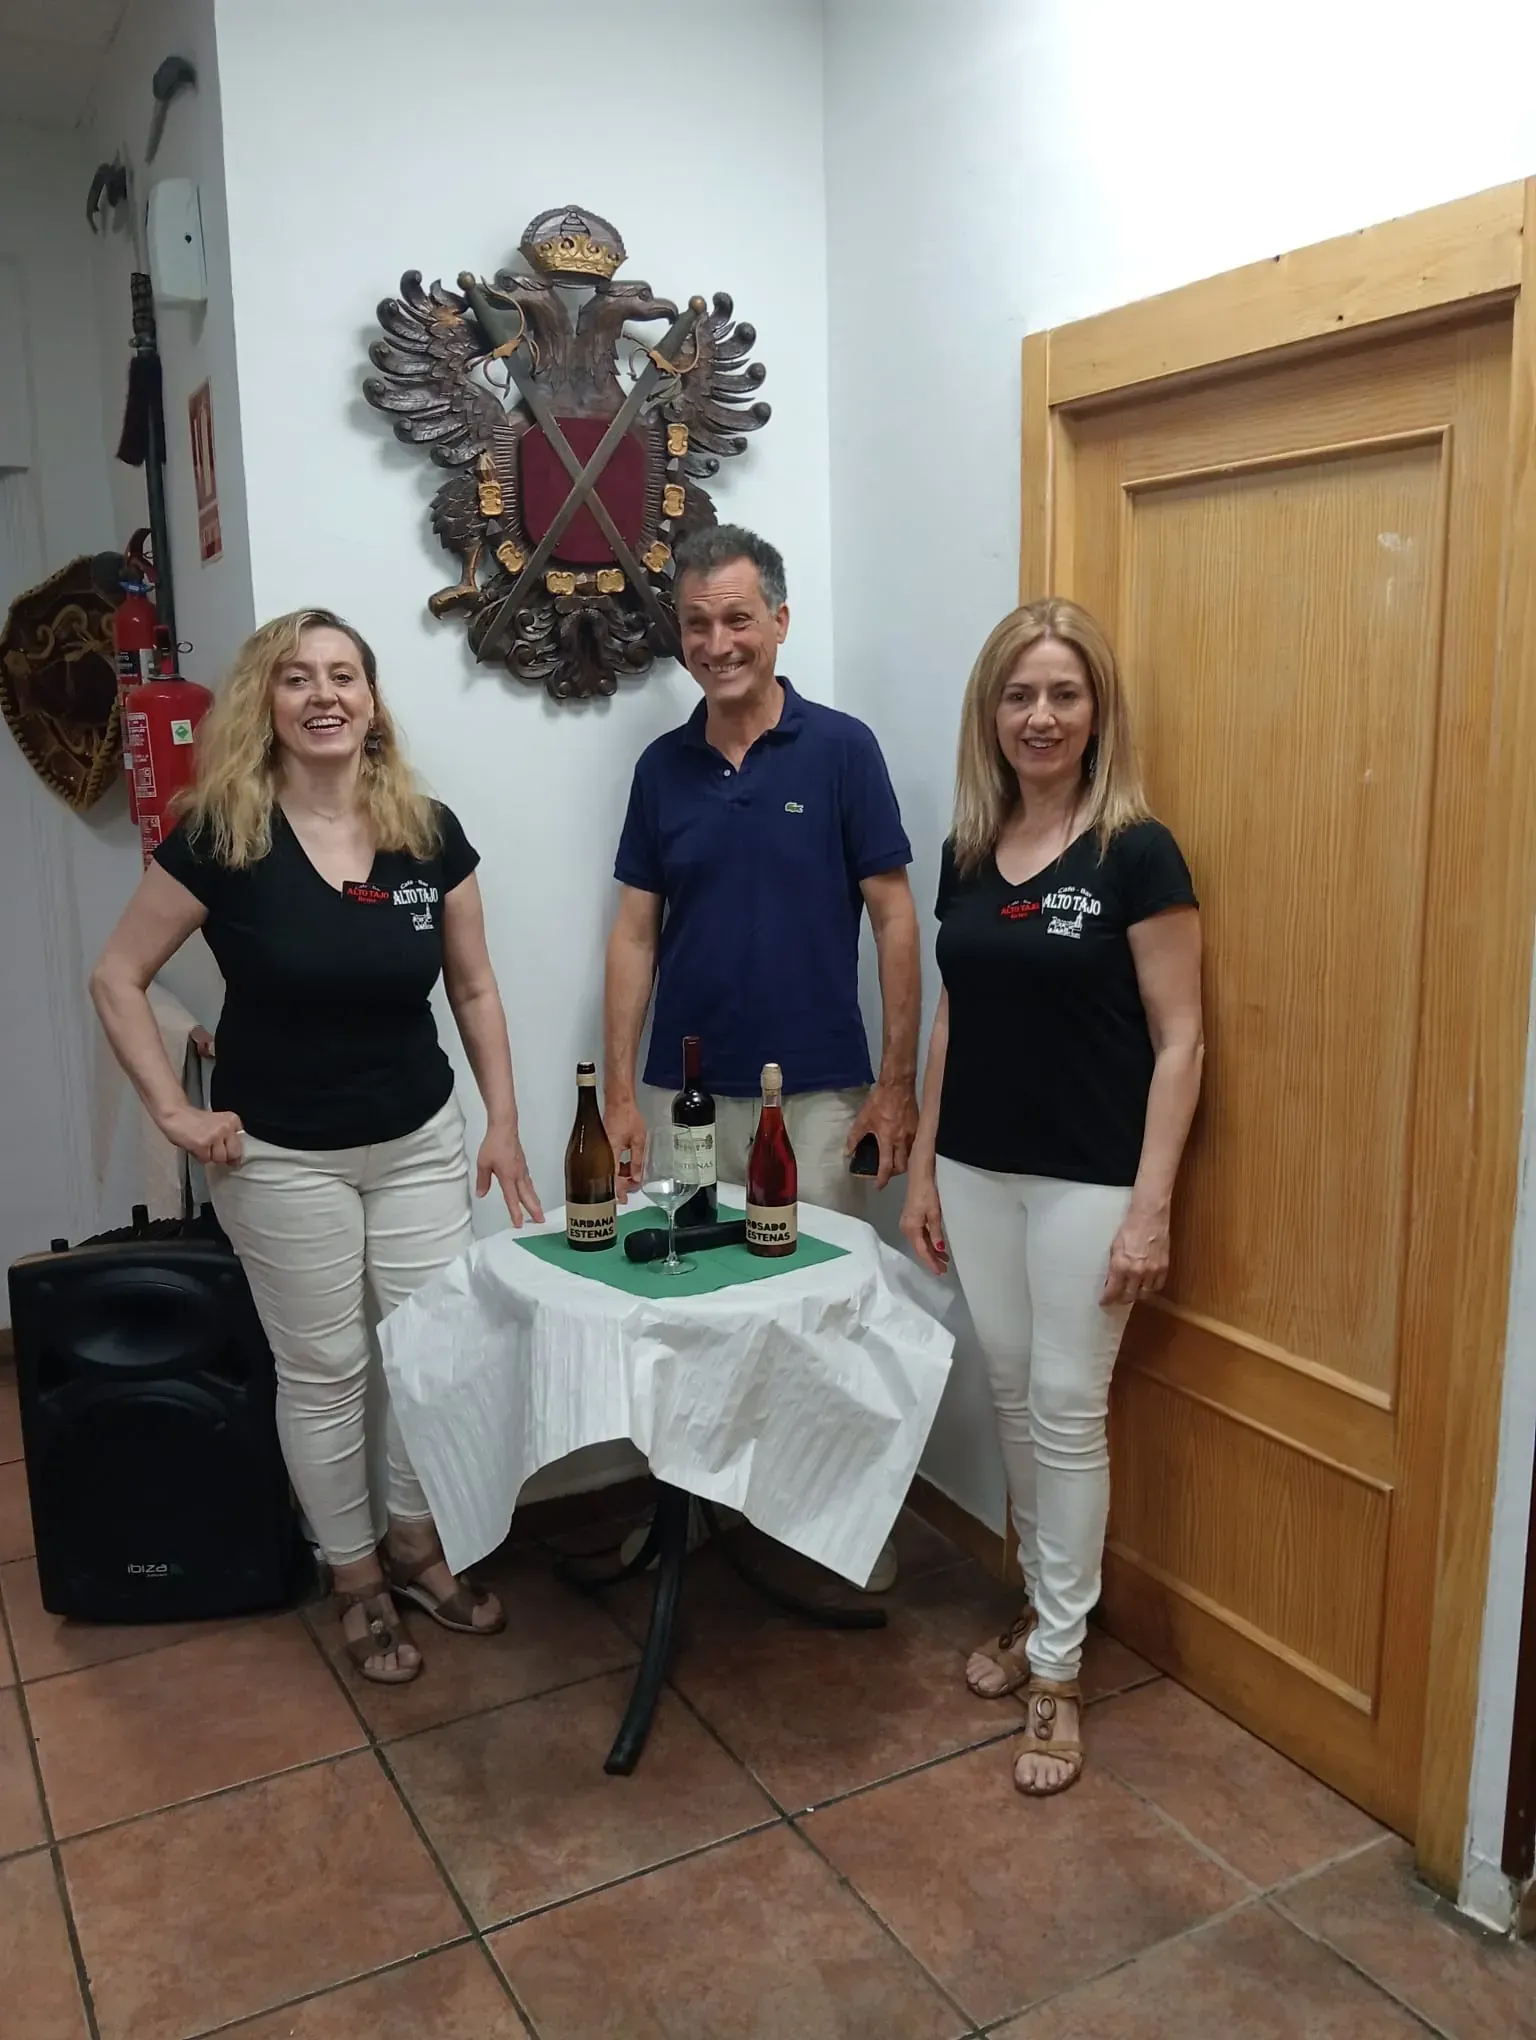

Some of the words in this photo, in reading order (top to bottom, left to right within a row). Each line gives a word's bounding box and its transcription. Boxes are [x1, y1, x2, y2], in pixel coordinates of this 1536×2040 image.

[346, 887, 368, 896] ALTO
[370, 890, 390, 899] TAJO
[392, 888, 417, 905] ALTO
[417, 887, 439, 903] TAJO
[1043, 893, 1072, 910] ALTO
[1073, 896, 1101, 916] TAJO
[568, 1216, 614, 1228] TARDANA
[746, 1218, 787, 1231] ROSADO
[570, 1227, 614, 1238] ESTENAS
[747, 1230, 791, 1241] ESTENAS
[127, 1563, 168, 1574] ibiza
